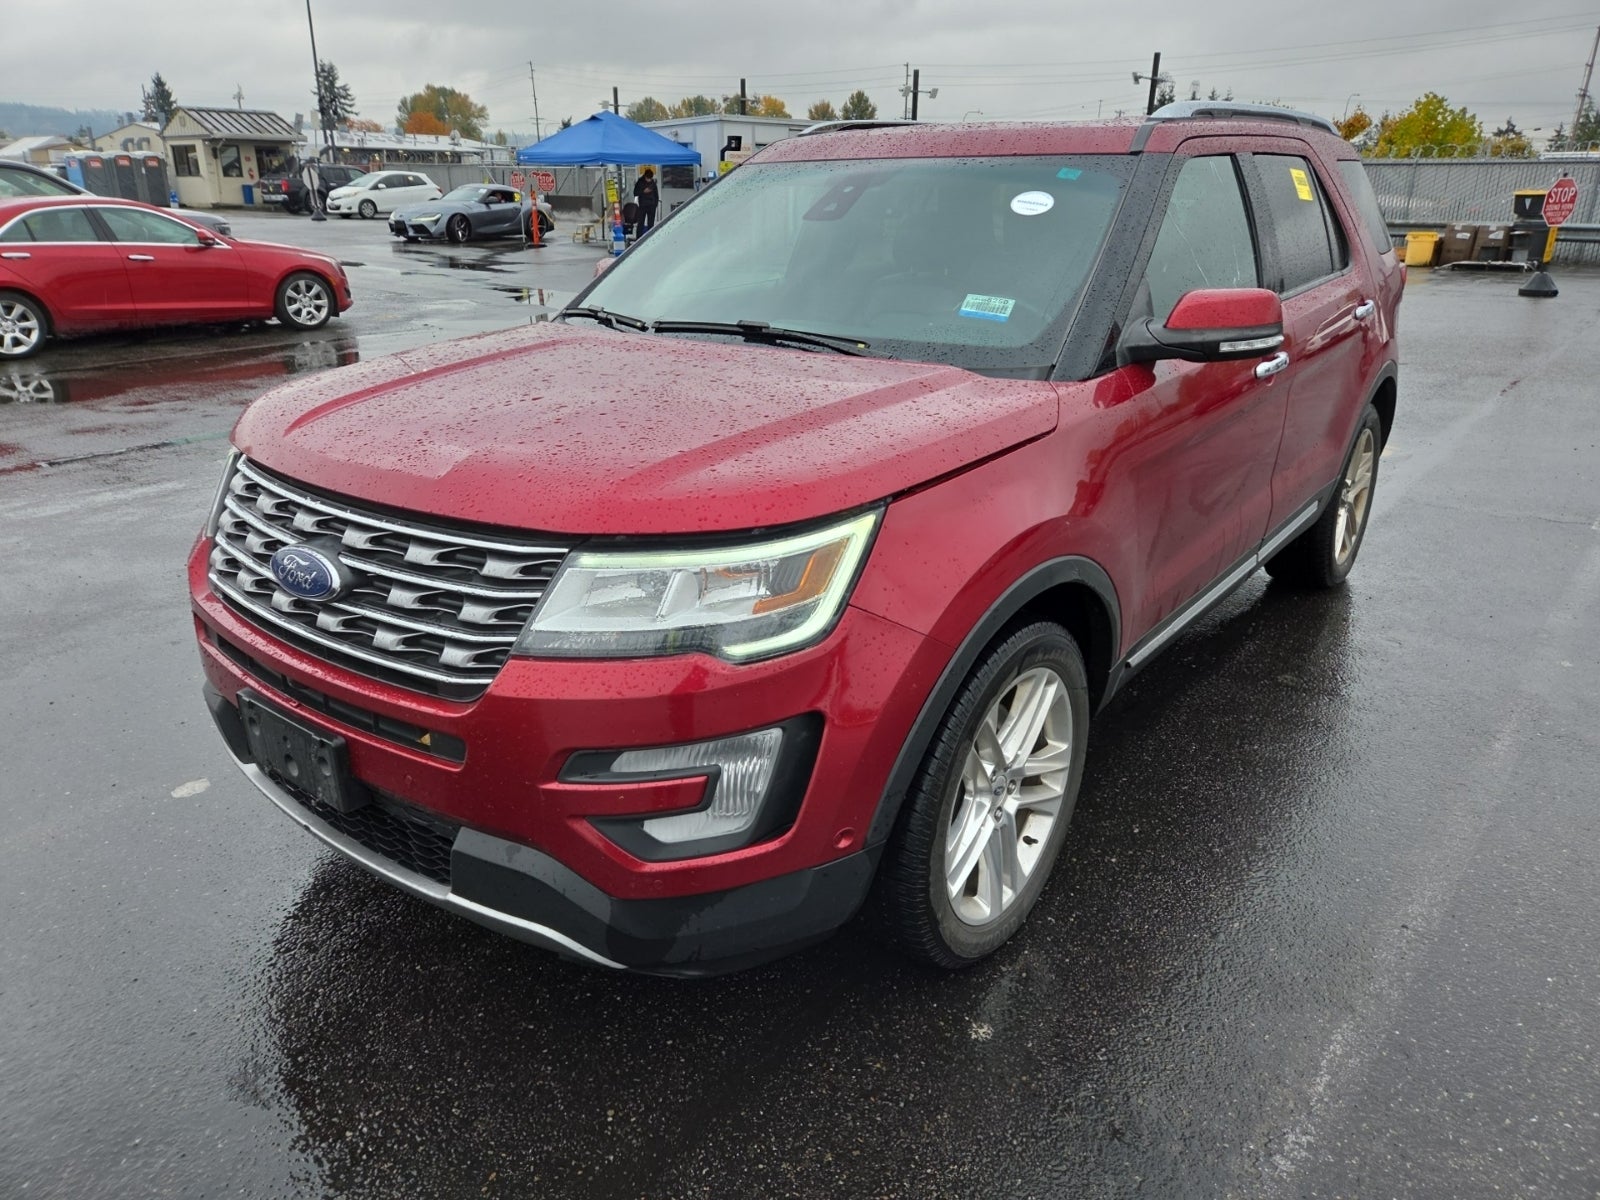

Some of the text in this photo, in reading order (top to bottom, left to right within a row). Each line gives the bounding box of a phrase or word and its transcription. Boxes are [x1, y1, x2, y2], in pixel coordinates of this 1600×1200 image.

[539, 175, 554, 184] STOP
[1548, 187, 1576, 204] STOP
[278, 554, 317, 590] Ford
